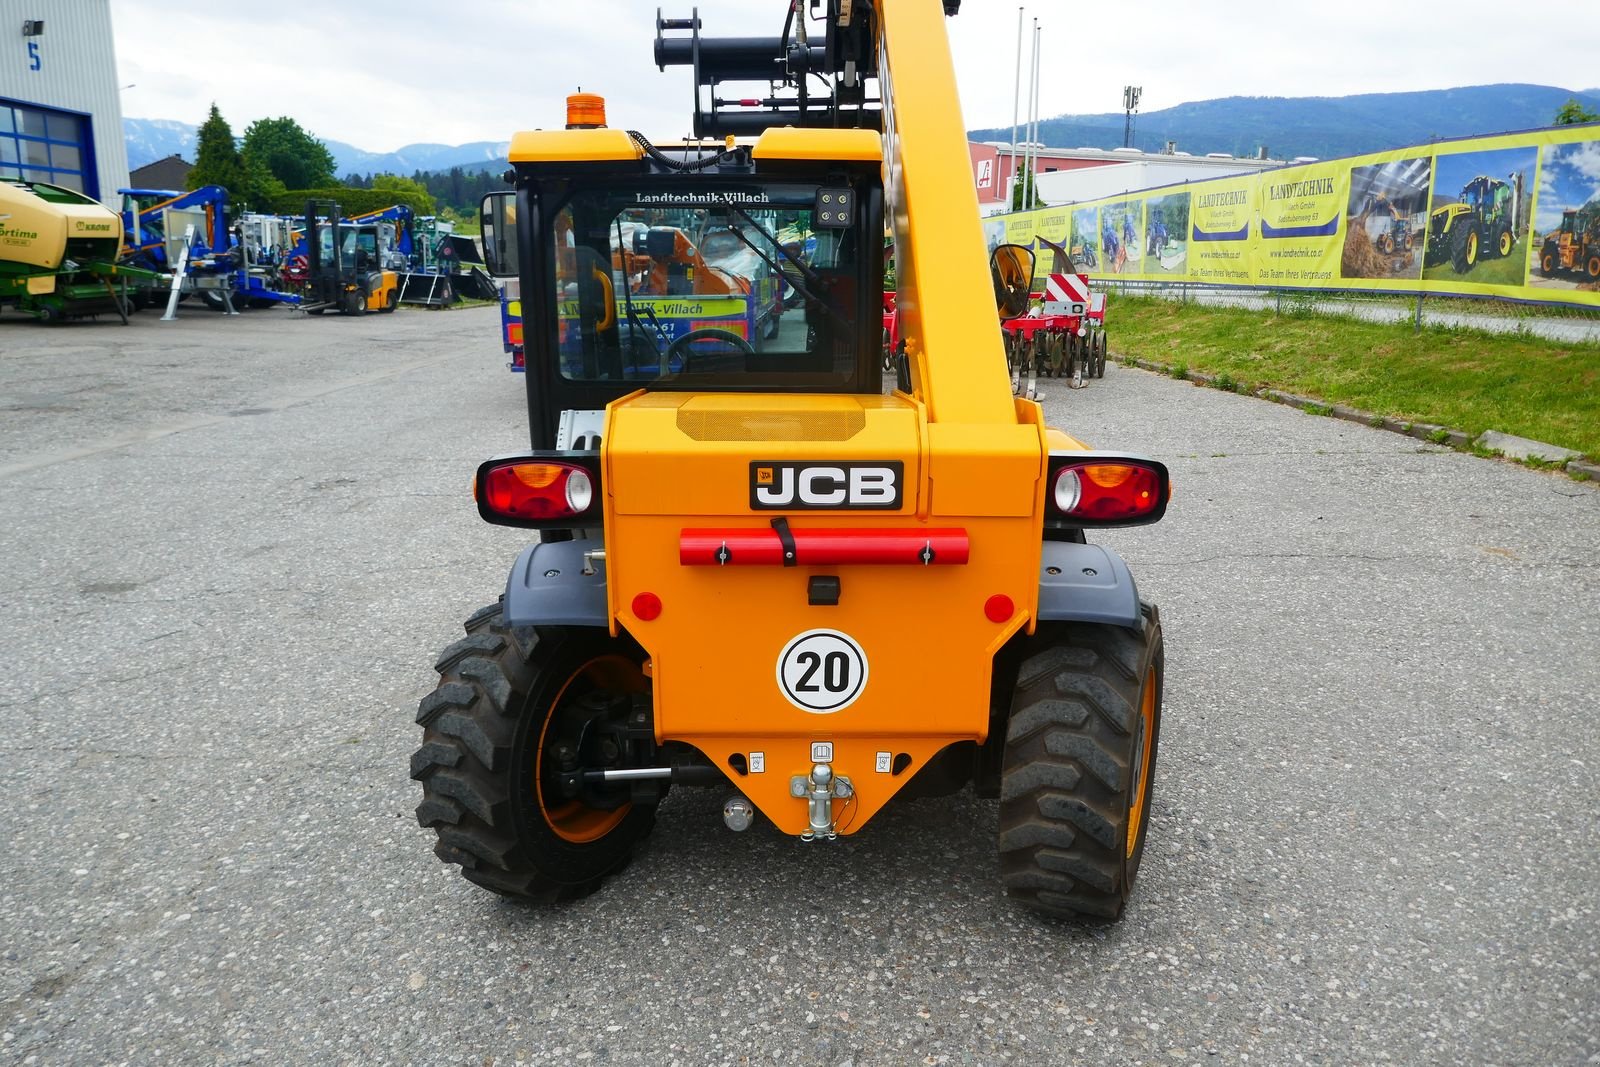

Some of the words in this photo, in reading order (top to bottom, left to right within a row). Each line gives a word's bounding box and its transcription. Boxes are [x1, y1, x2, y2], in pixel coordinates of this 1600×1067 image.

[28, 42, 40, 71] 5
[636, 192, 770, 203] Landtechnik-Villach
[1199, 190, 1247, 208] LANDTECHNIK
[1270, 177, 1334, 200] LANDTECHNIK
[1259, 269, 1269, 278] Das
[1270, 269, 1284, 278] Team
[757, 467, 896, 505] JCB
[795, 651, 849, 692] 20
